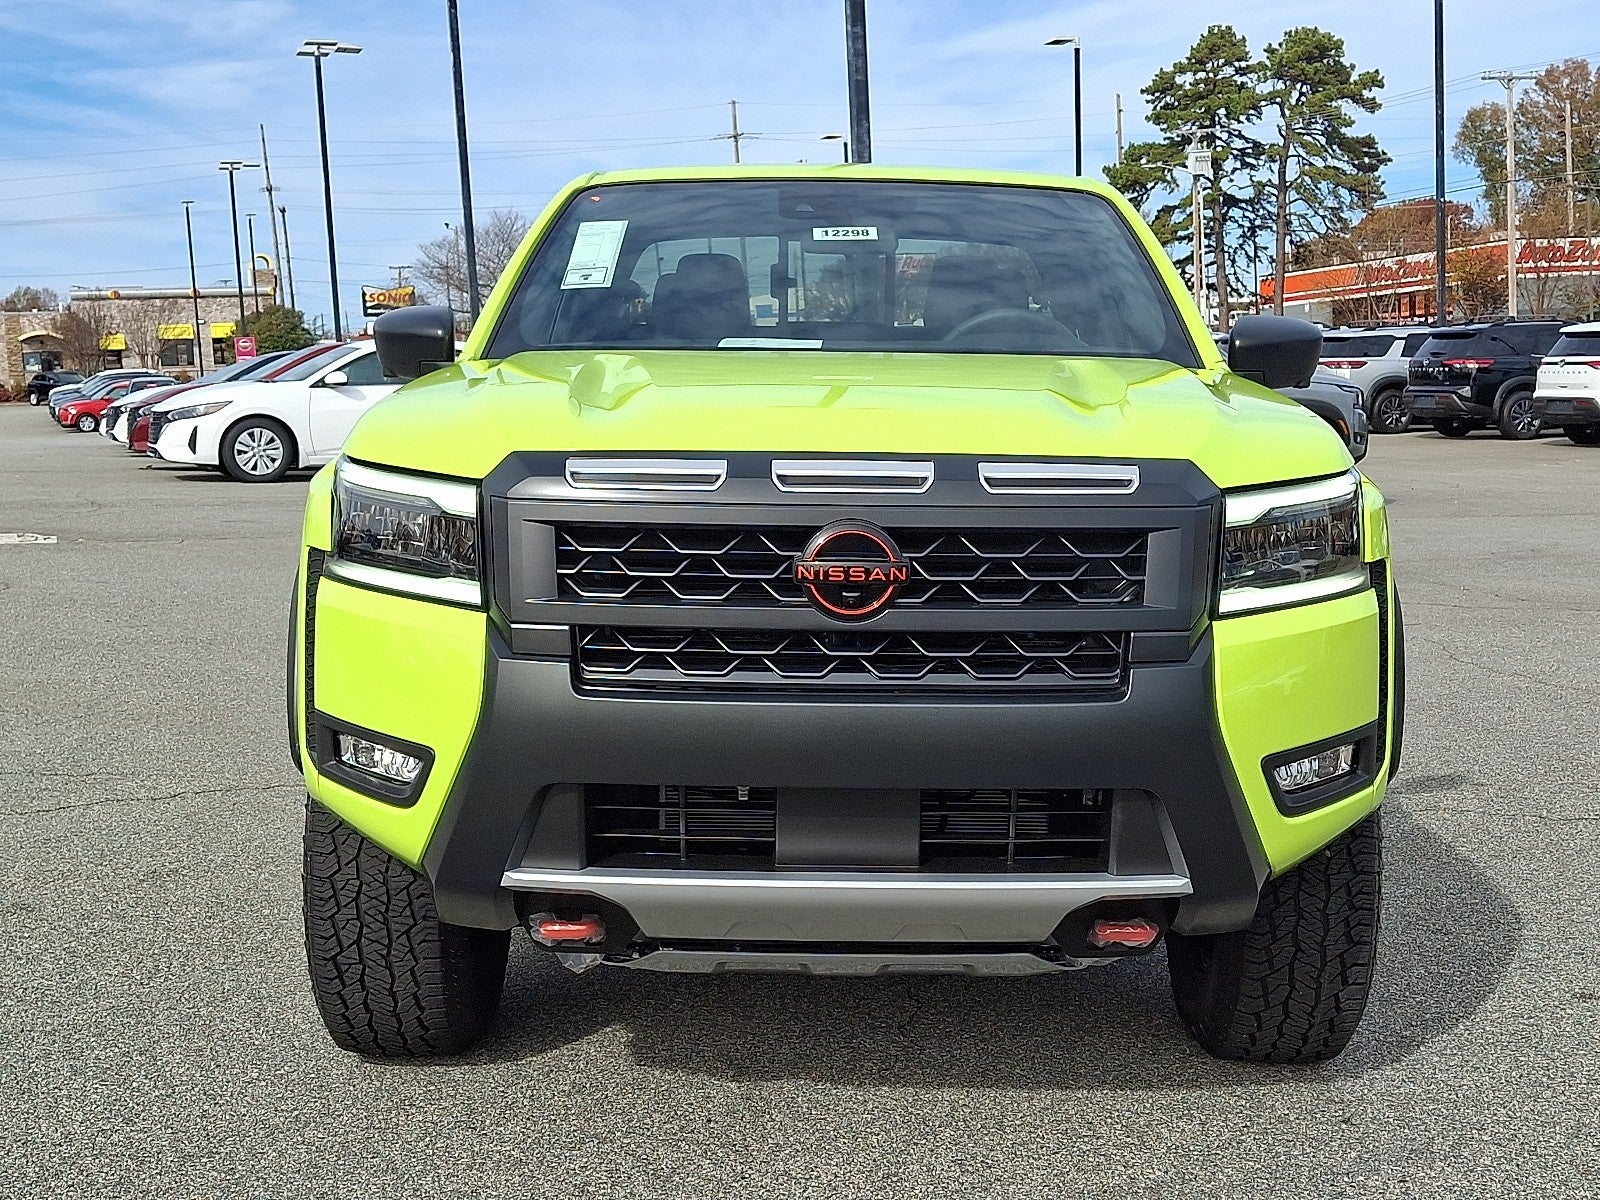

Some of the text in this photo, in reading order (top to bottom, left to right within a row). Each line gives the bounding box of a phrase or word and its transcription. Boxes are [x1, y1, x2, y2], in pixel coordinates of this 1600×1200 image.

[821, 229, 870, 237] 12298
[368, 292, 413, 303] SONIC
[796, 565, 908, 581] NISSAN
